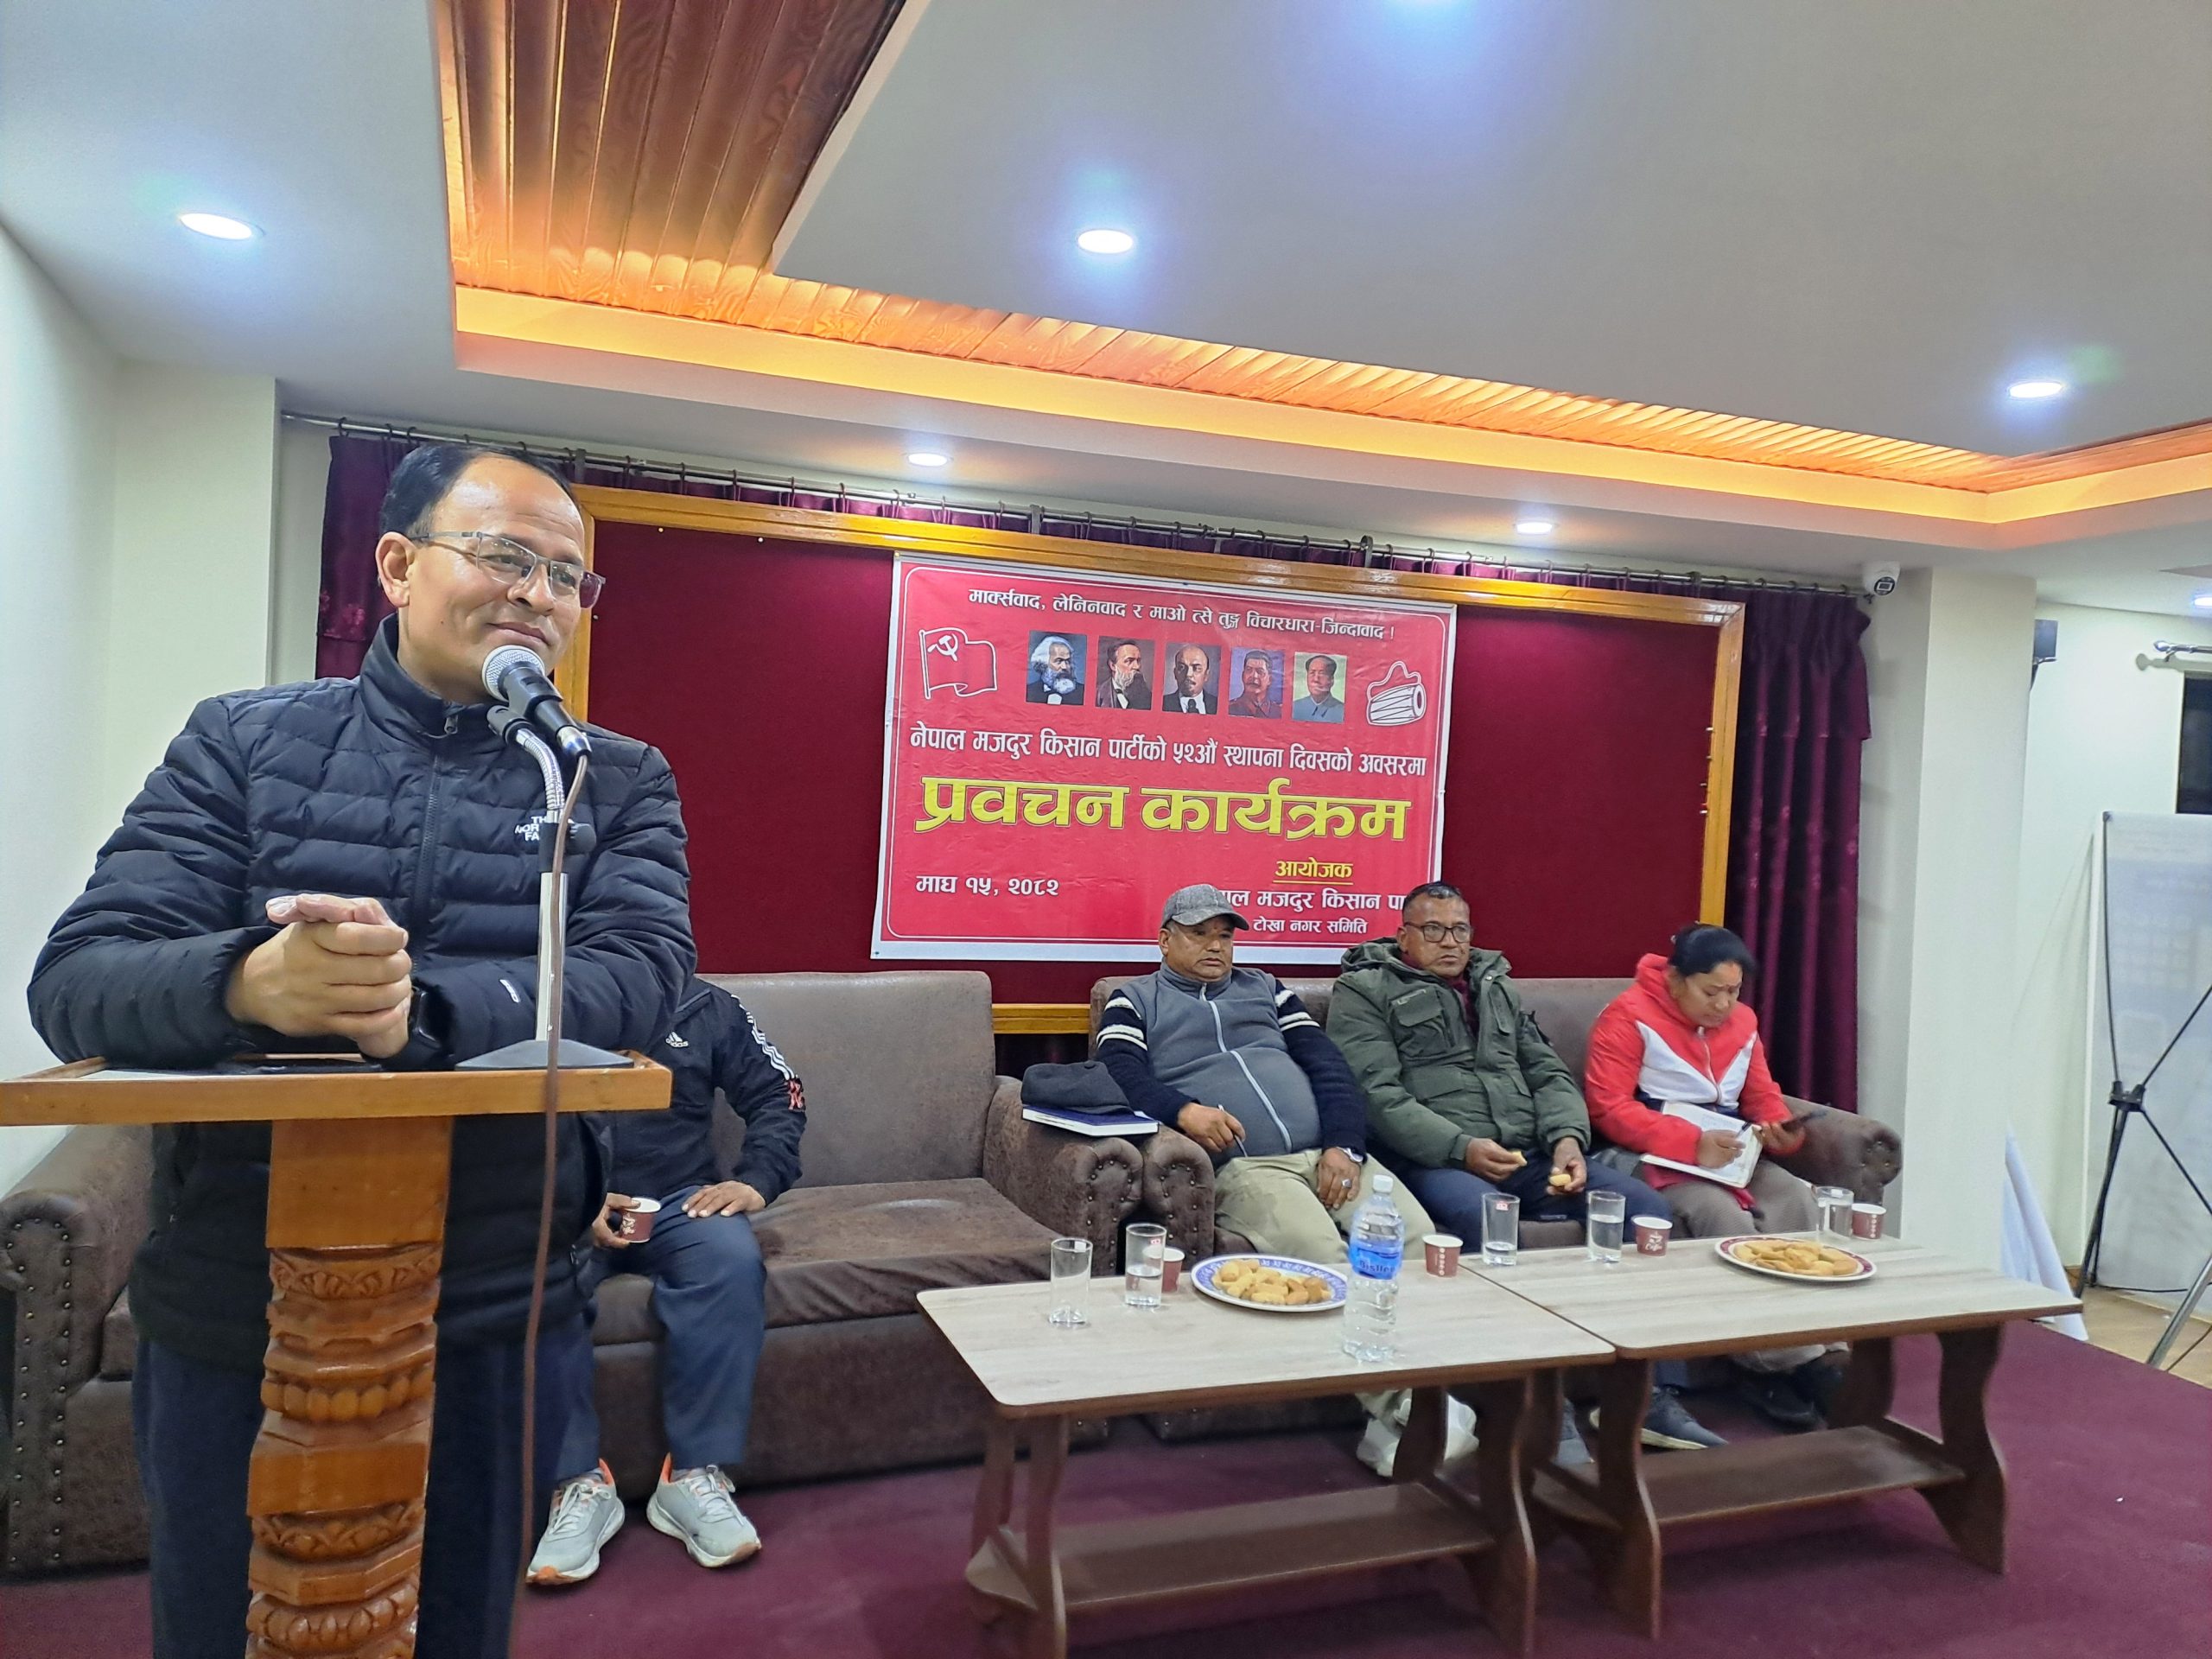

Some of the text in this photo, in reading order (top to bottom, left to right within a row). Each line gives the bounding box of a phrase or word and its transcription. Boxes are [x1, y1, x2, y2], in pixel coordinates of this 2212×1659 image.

[968, 588, 1046, 610] मार्क्सवाद,
[1052, 593, 1128, 617] लेनिनवाद
[1133, 604, 1144, 619] र
[1149, 604, 1187, 622] माओ
[910, 721, 1427, 777] नेपाल मजदुर किसान पार्टीको ५२औं स्थापना दिवसको अवसरमा
[914, 777, 1412, 840] प्रवचन कार्यक्रम
[514, 823, 540, 835] NOR
[531, 816, 546, 824] TH
[524, 831, 540, 842] FA
[1274, 857, 1353, 878] आयोजक
[916, 875, 1059, 896] माघ १५, २०८२
[1256, 891, 1315, 912] मजदुर
[1322, 887, 1382, 910] किसान
[1252, 915, 1368, 934] टोखा नगर समिति
